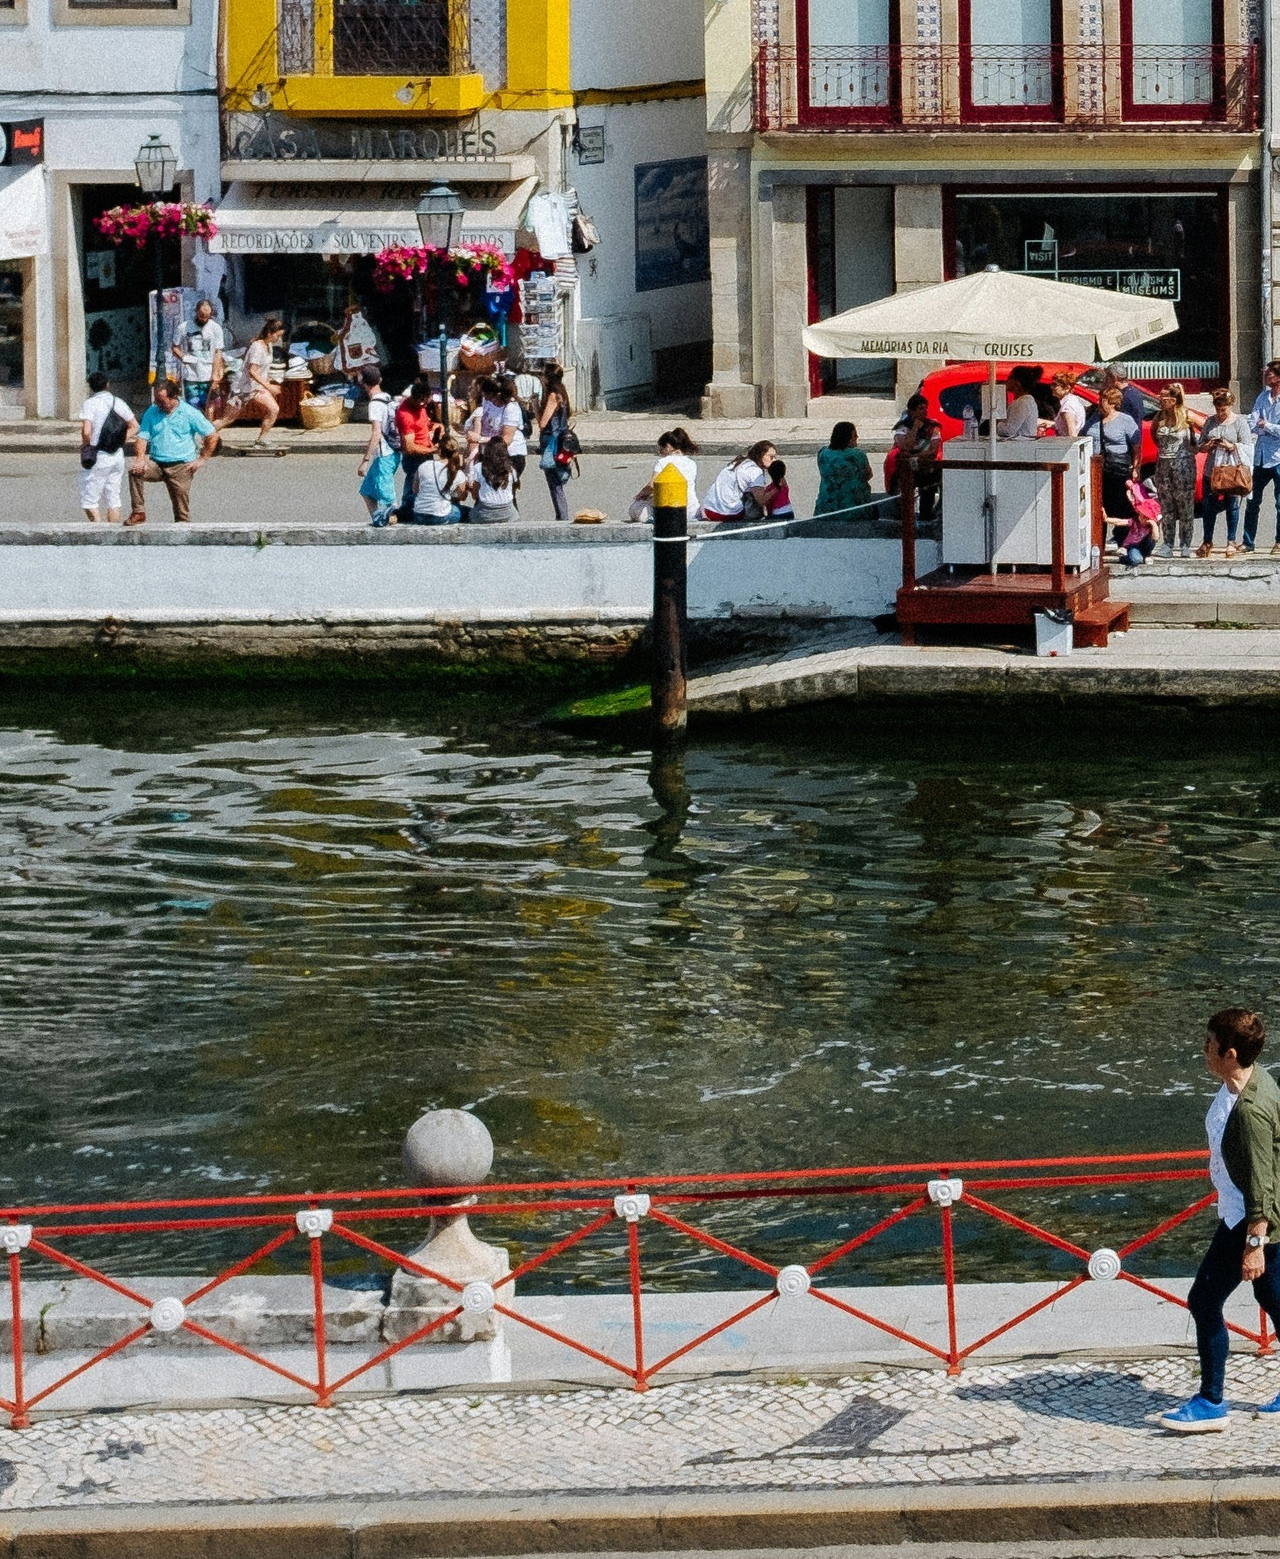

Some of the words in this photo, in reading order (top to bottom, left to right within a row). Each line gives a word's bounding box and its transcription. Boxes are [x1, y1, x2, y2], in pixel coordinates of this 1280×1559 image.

[236, 129, 322, 159] CASA
[351, 129, 497, 158] MARQUES
[334, 232, 406, 249] SOUVENIRS
[1029, 251, 1053, 261] VISIT
[1122, 276, 1164, 285] TOURISM
[1122, 285, 1175, 295] MUSEUMS
[860, 337, 913, 354] MEMÓRIAS
[915, 341, 929, 354] DA
[932, 341, 949, 354] RIA
[984, 342, 1035, 357] CRUISES
